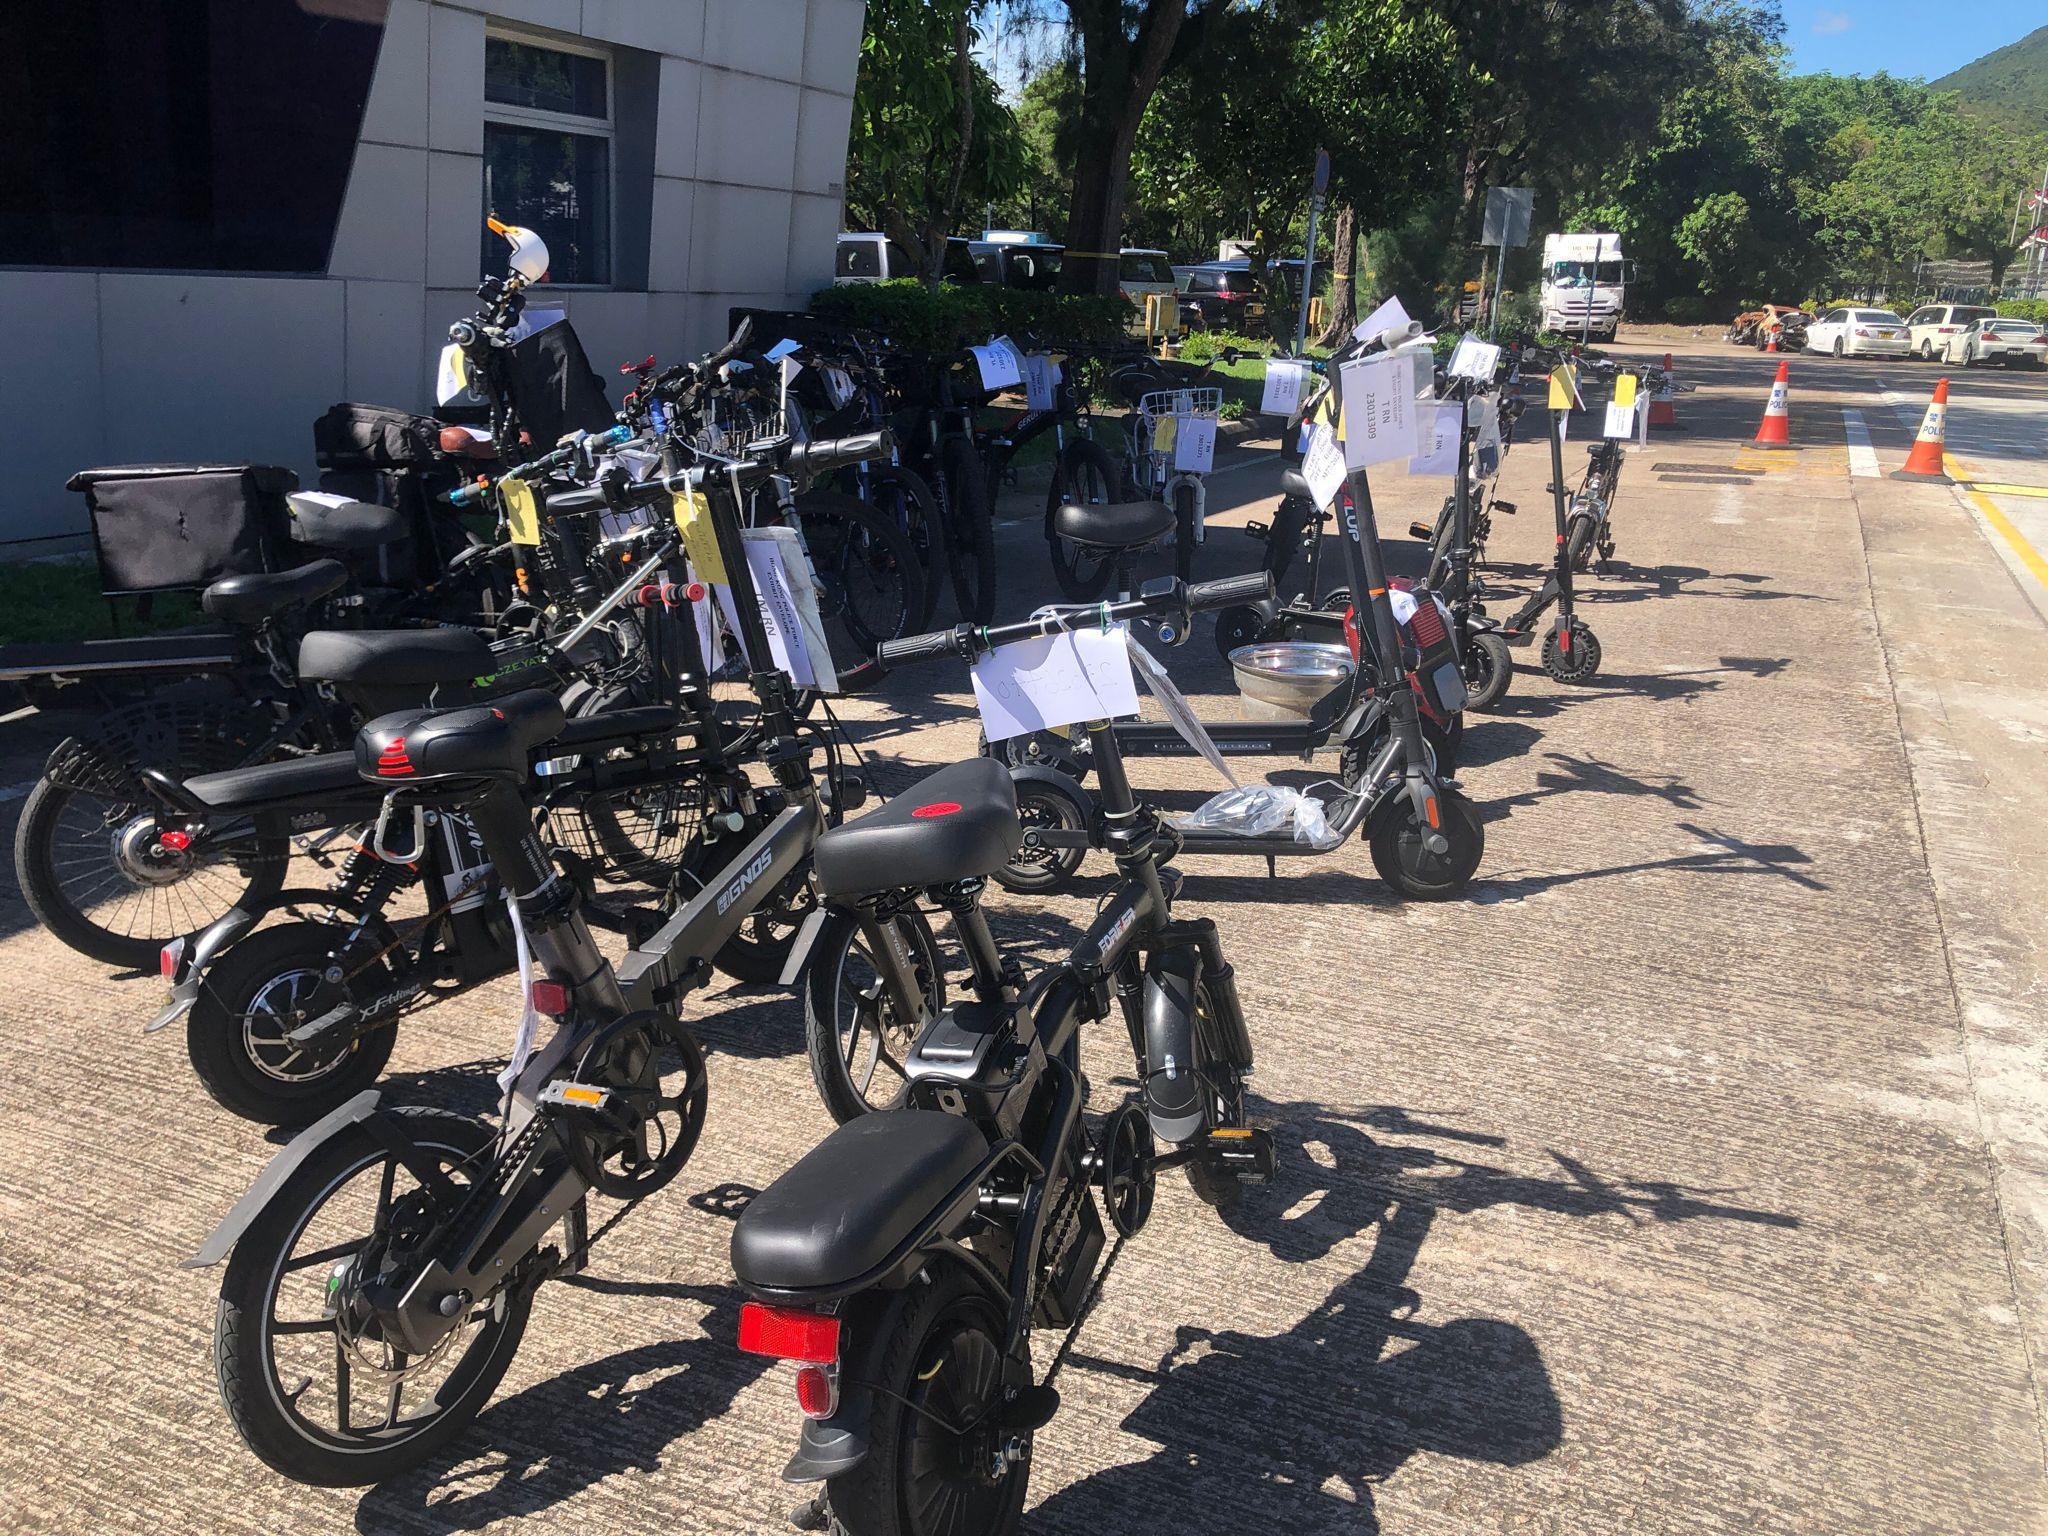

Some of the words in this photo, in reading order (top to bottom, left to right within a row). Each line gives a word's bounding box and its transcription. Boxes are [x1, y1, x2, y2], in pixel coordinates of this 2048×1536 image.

[1769, 400, 1788, 409] POLIC
[1366, 392, 1377, 440] 23013309
[1381, 411, 1391, 424] RN
[1922, 425, 1945, 436] POLIC
[767, 572, 778, 599] EXHIBIT
[776, 601, 790, 635] ENVELOPE
[765, 617, 776, 636] RN
[782, 601, 793, 625] POLICE
[791, 627, 800, 649] FORCE
